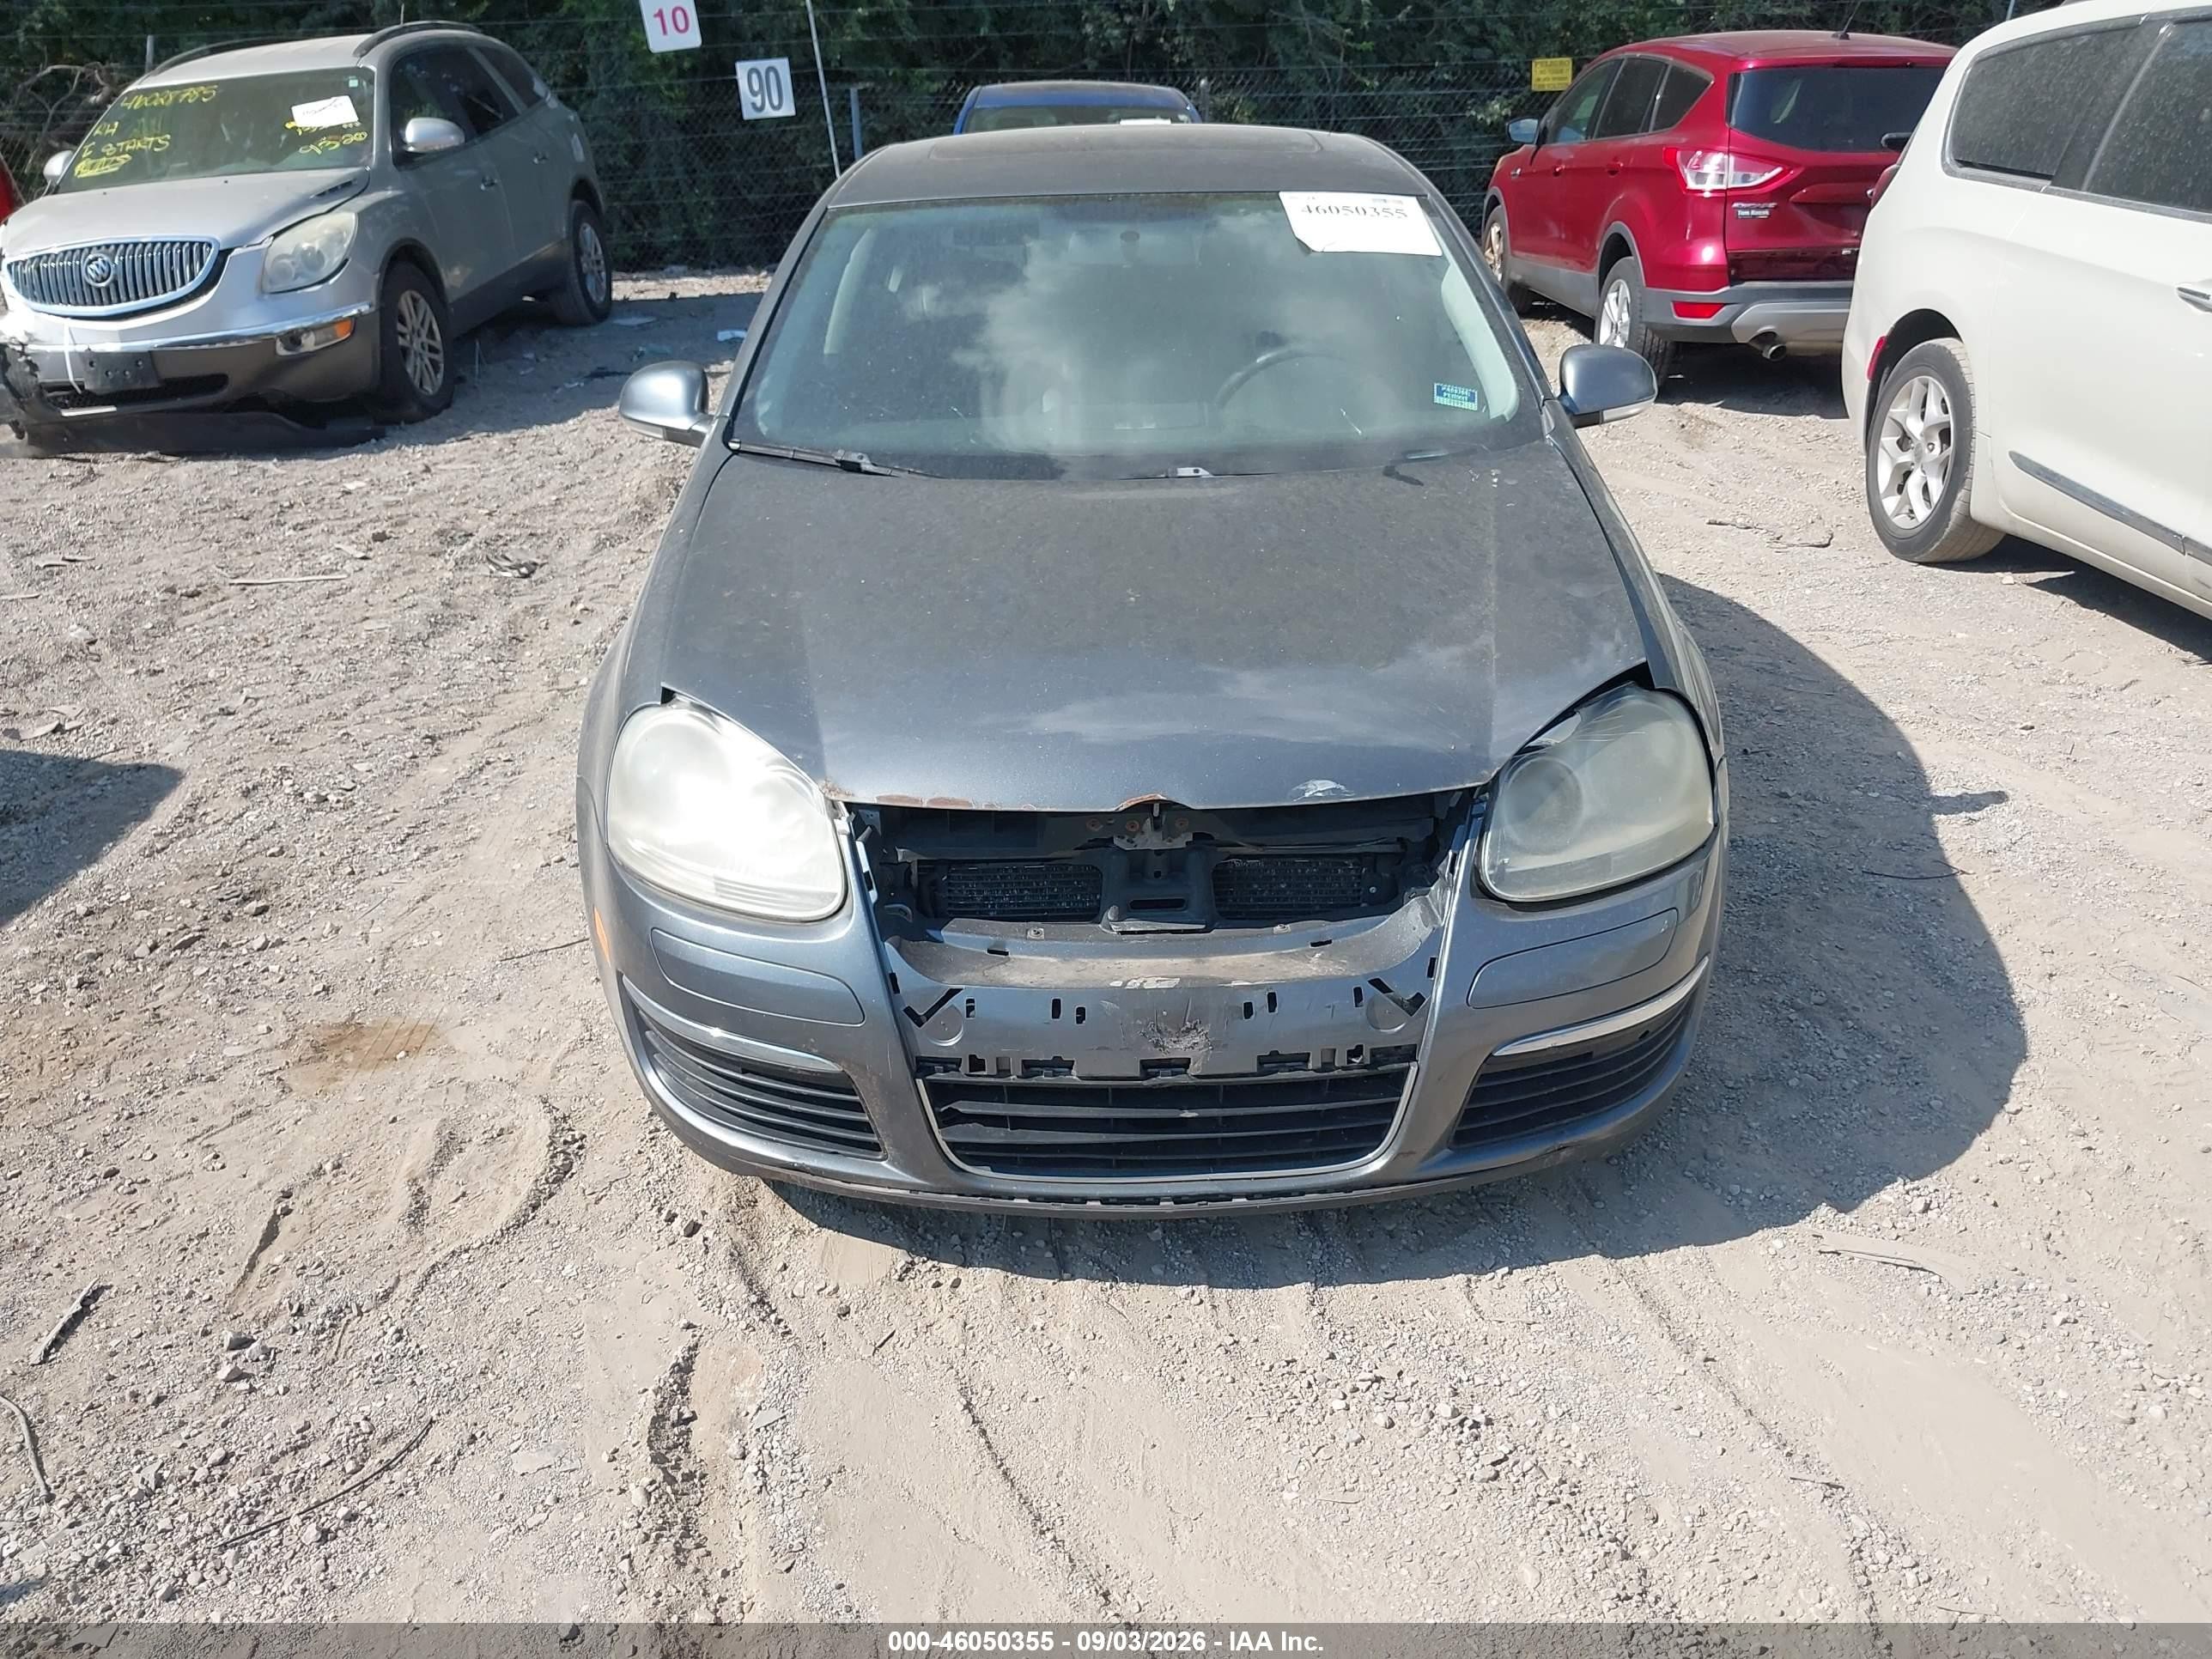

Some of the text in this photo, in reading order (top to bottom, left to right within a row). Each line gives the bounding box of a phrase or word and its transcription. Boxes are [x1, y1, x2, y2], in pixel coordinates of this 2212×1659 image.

[653, 6, 690, 36] 10
[747, 65, 784, 113] 90
[1301, 204, 1408, 219] 46050355
